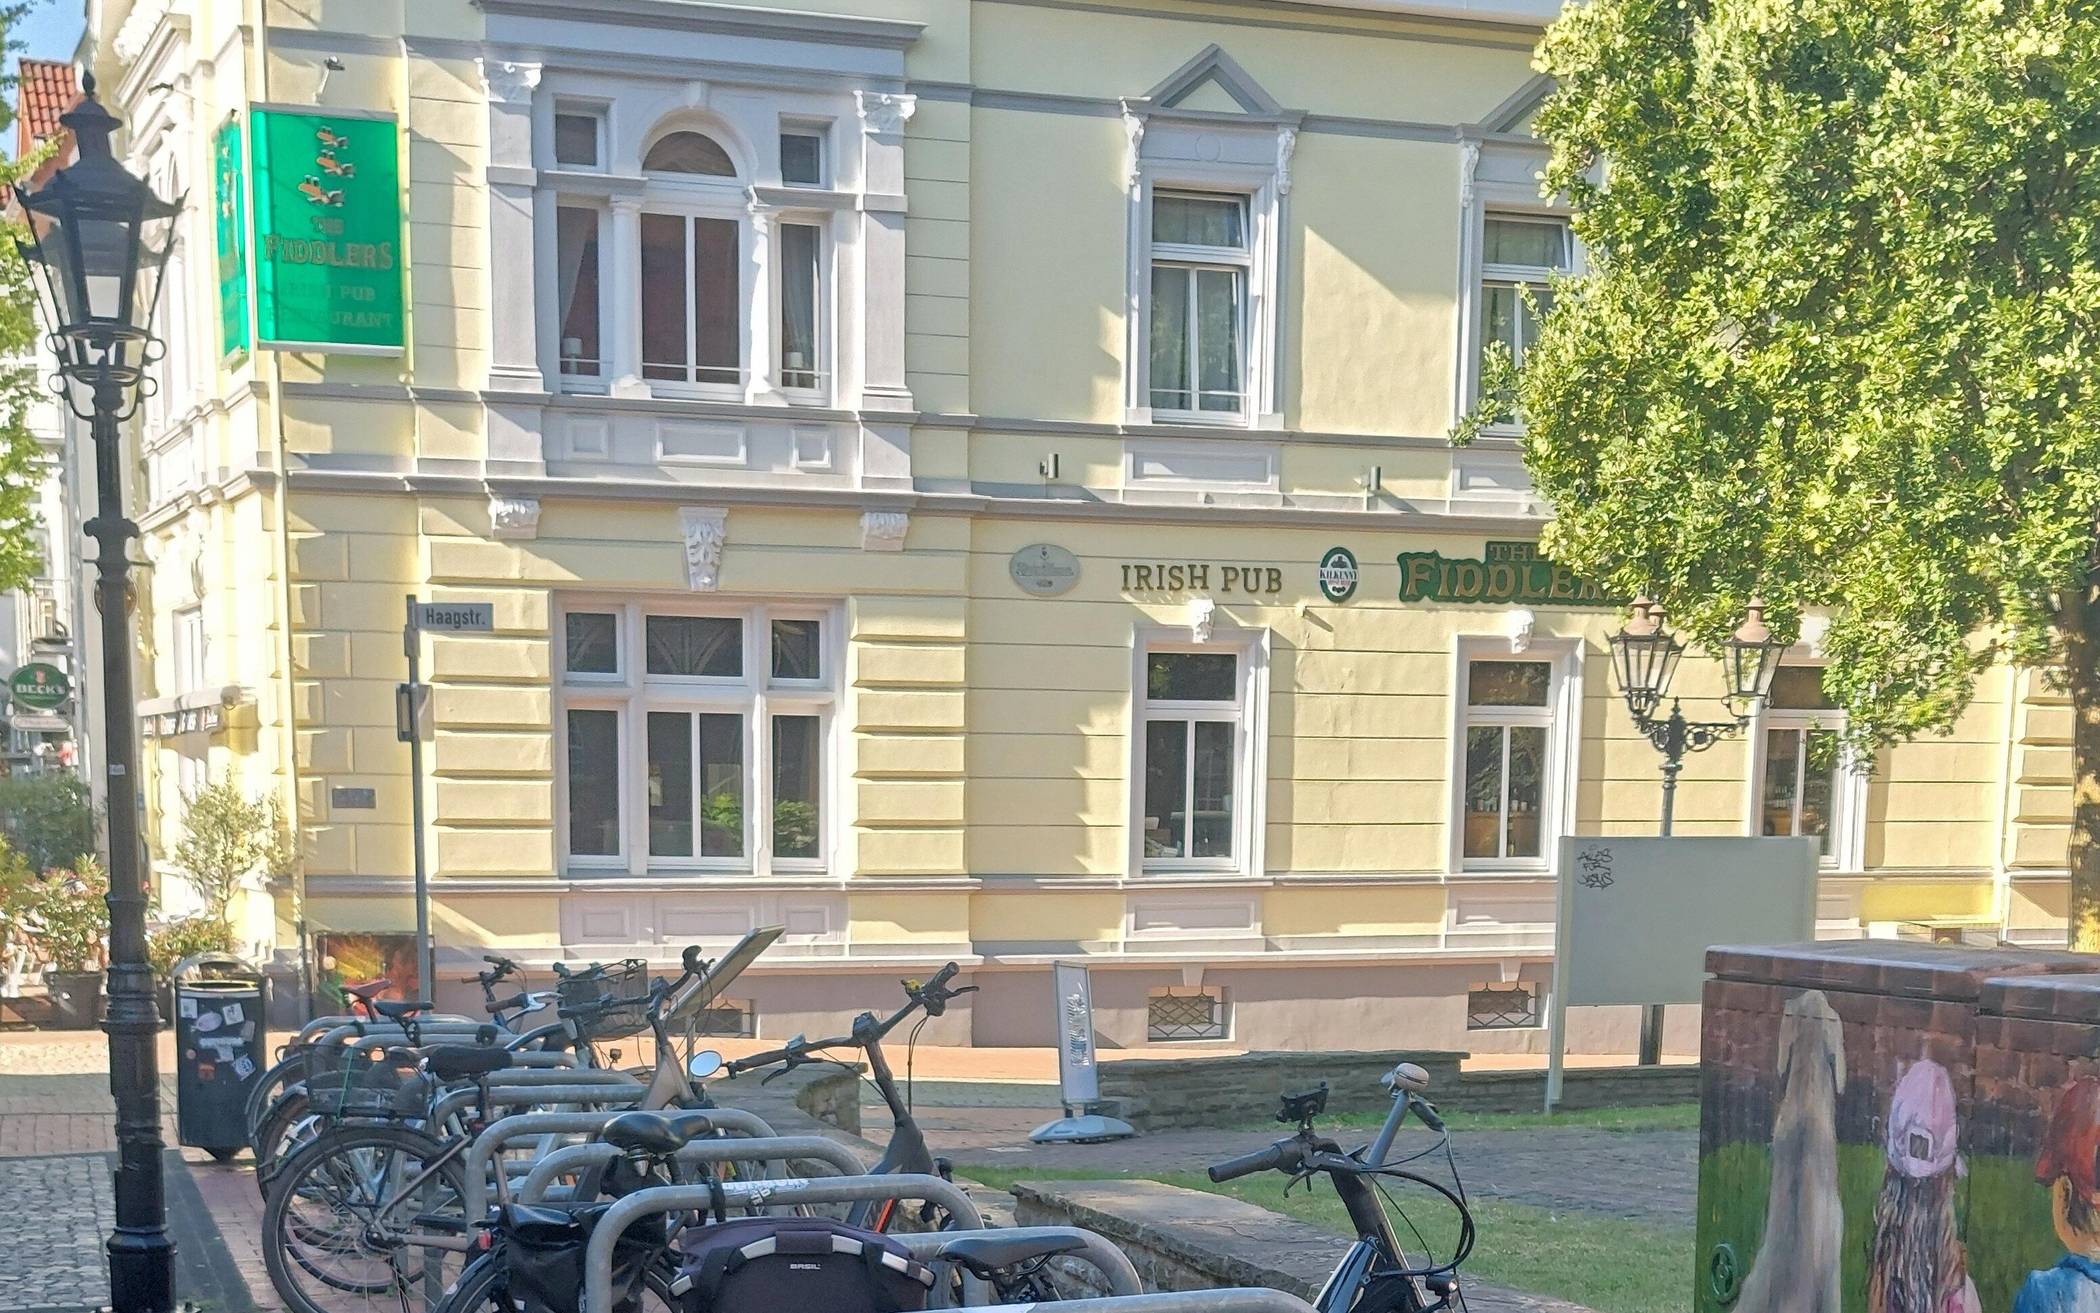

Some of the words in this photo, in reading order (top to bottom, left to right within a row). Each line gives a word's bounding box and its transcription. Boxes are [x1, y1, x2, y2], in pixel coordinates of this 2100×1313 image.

[264, 234, 393, 270] FIDDLERS
[341, 286, 376, 301] PUB
[1121, 564, 1210, 591] IRISH
[1221, 566, 1283, 593] PUB
[1405, 557, 1615, 601] FIDDLER
[426, 607, 486, 629] Haagstr.
